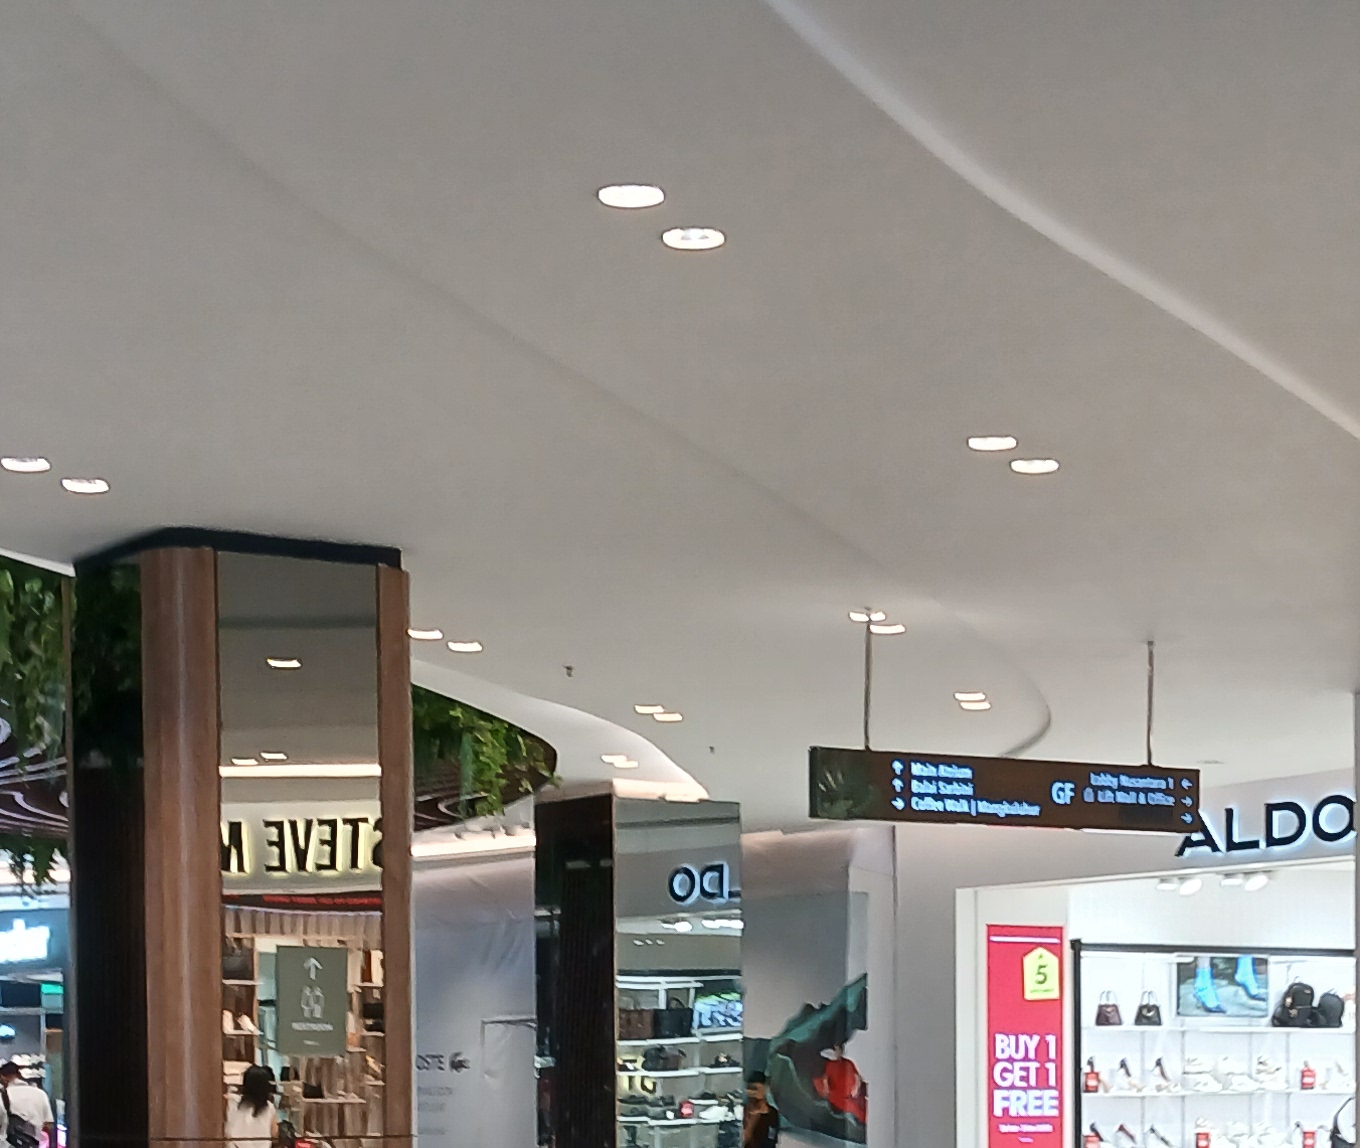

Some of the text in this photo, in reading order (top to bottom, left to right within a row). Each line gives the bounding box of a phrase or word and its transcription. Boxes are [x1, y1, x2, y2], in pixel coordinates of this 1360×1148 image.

[1051, 781, 1075, 805] GF
[1174, 794, 1355, 857] ALDO
[1034, 963, 1048, 985] 5
[994, 1032, 1057, 1060] BUY 1
[992, 1060, 1057, 1088] GET 1
[992, 1088, 1060, 1117] FREE
